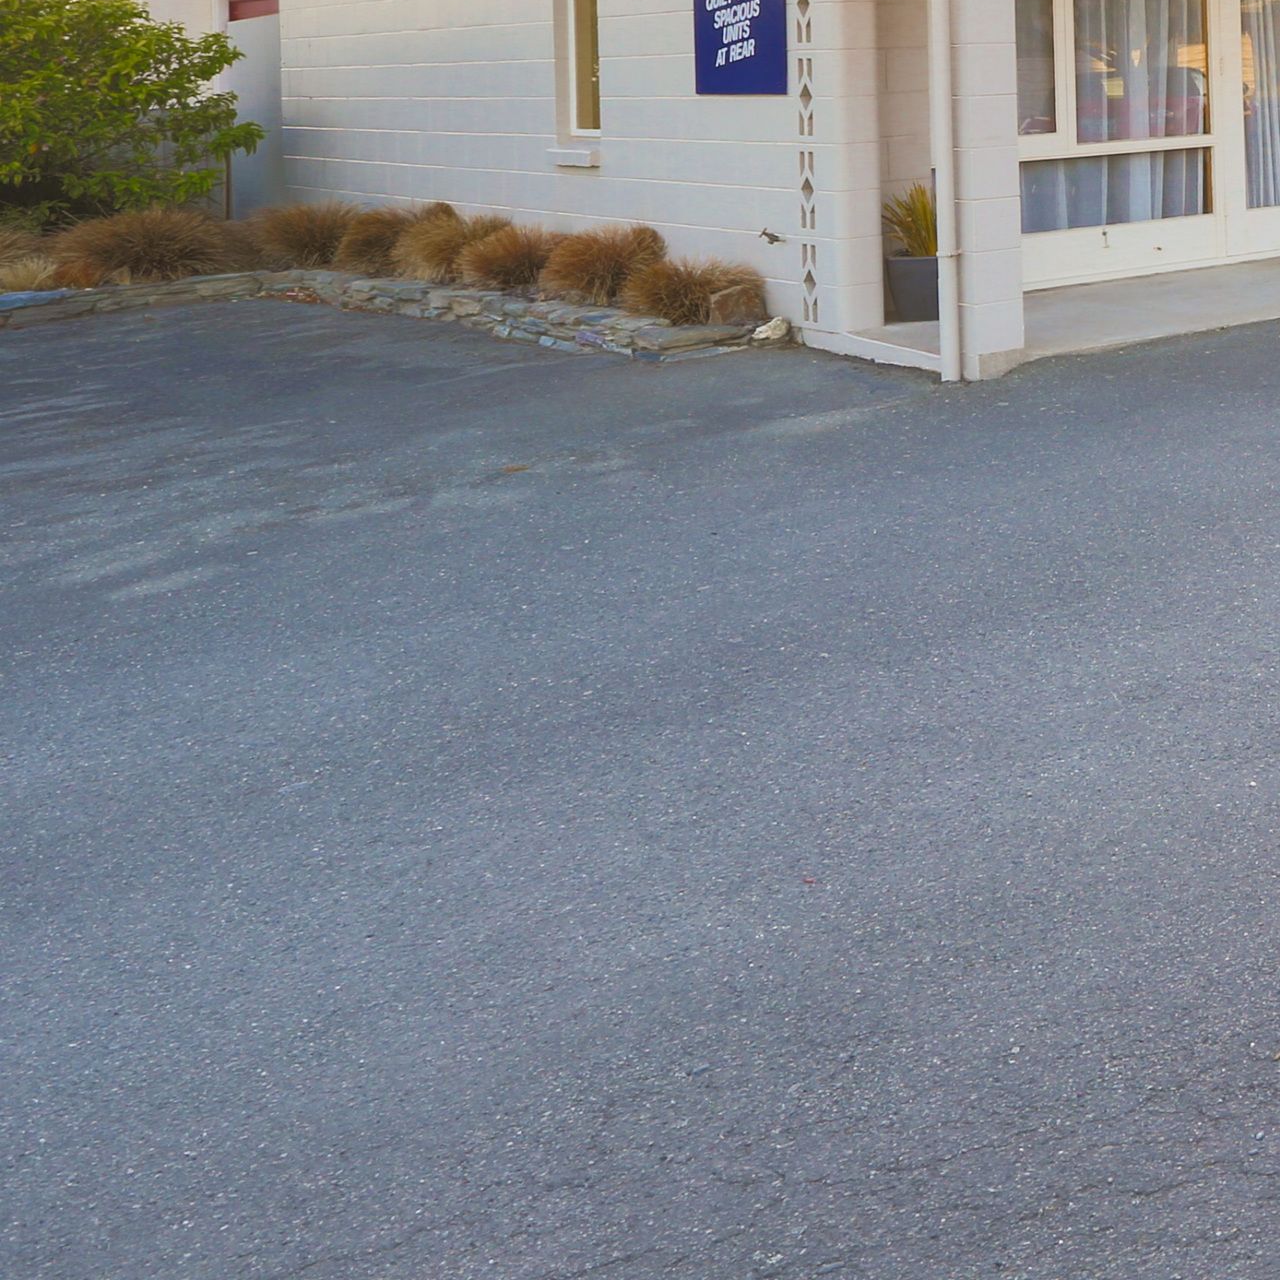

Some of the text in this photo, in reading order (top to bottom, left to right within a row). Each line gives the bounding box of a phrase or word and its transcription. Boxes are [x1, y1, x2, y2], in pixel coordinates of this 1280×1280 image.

[723, 20, 751, 44] UNITS
[715, 38, 755, 67] AT REAR
